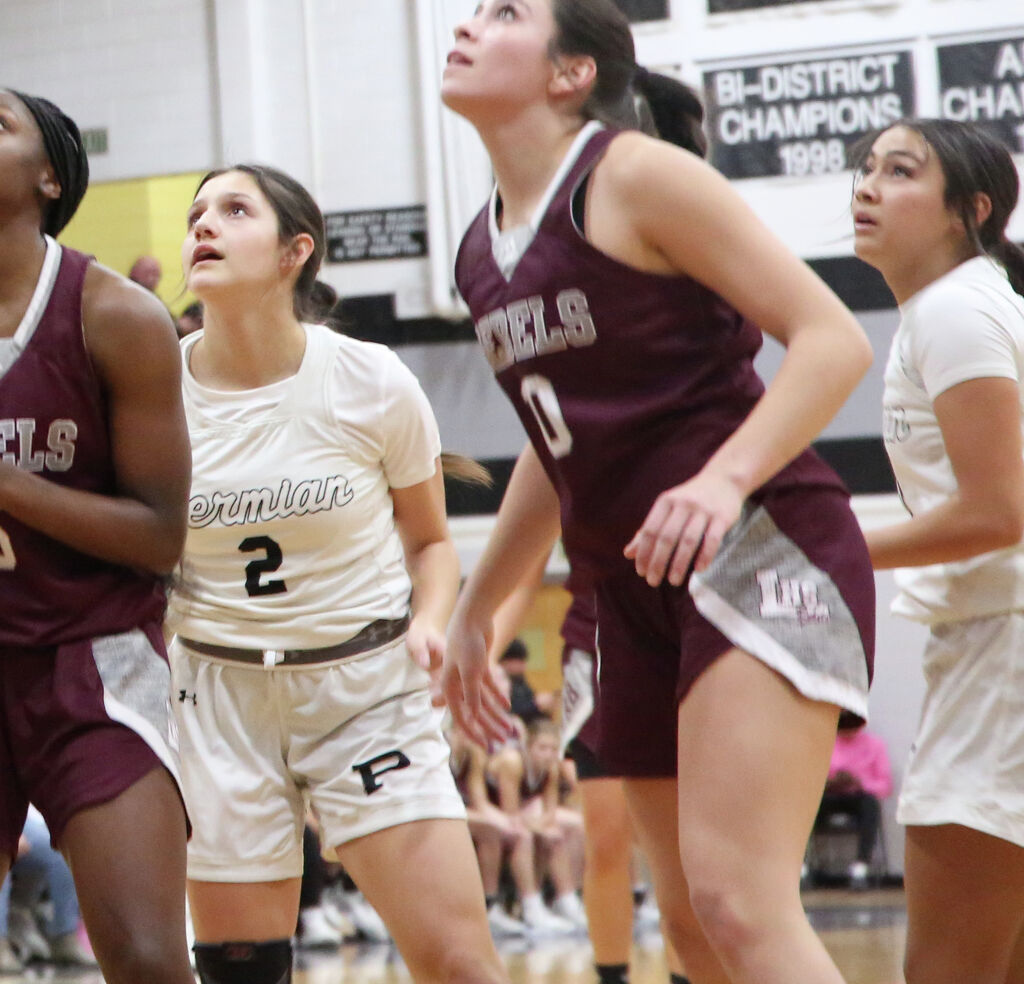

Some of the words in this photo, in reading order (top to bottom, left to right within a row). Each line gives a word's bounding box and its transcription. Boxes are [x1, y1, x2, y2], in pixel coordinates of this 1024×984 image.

[715, 54, 898, 106] BI-DISTRICT
[719, 92, 902, 145] CHAMPIONS
[779, 138, 846, 176] 1998
[238, 535, 288, 598] 2
[351, 749, 411, 796] P
